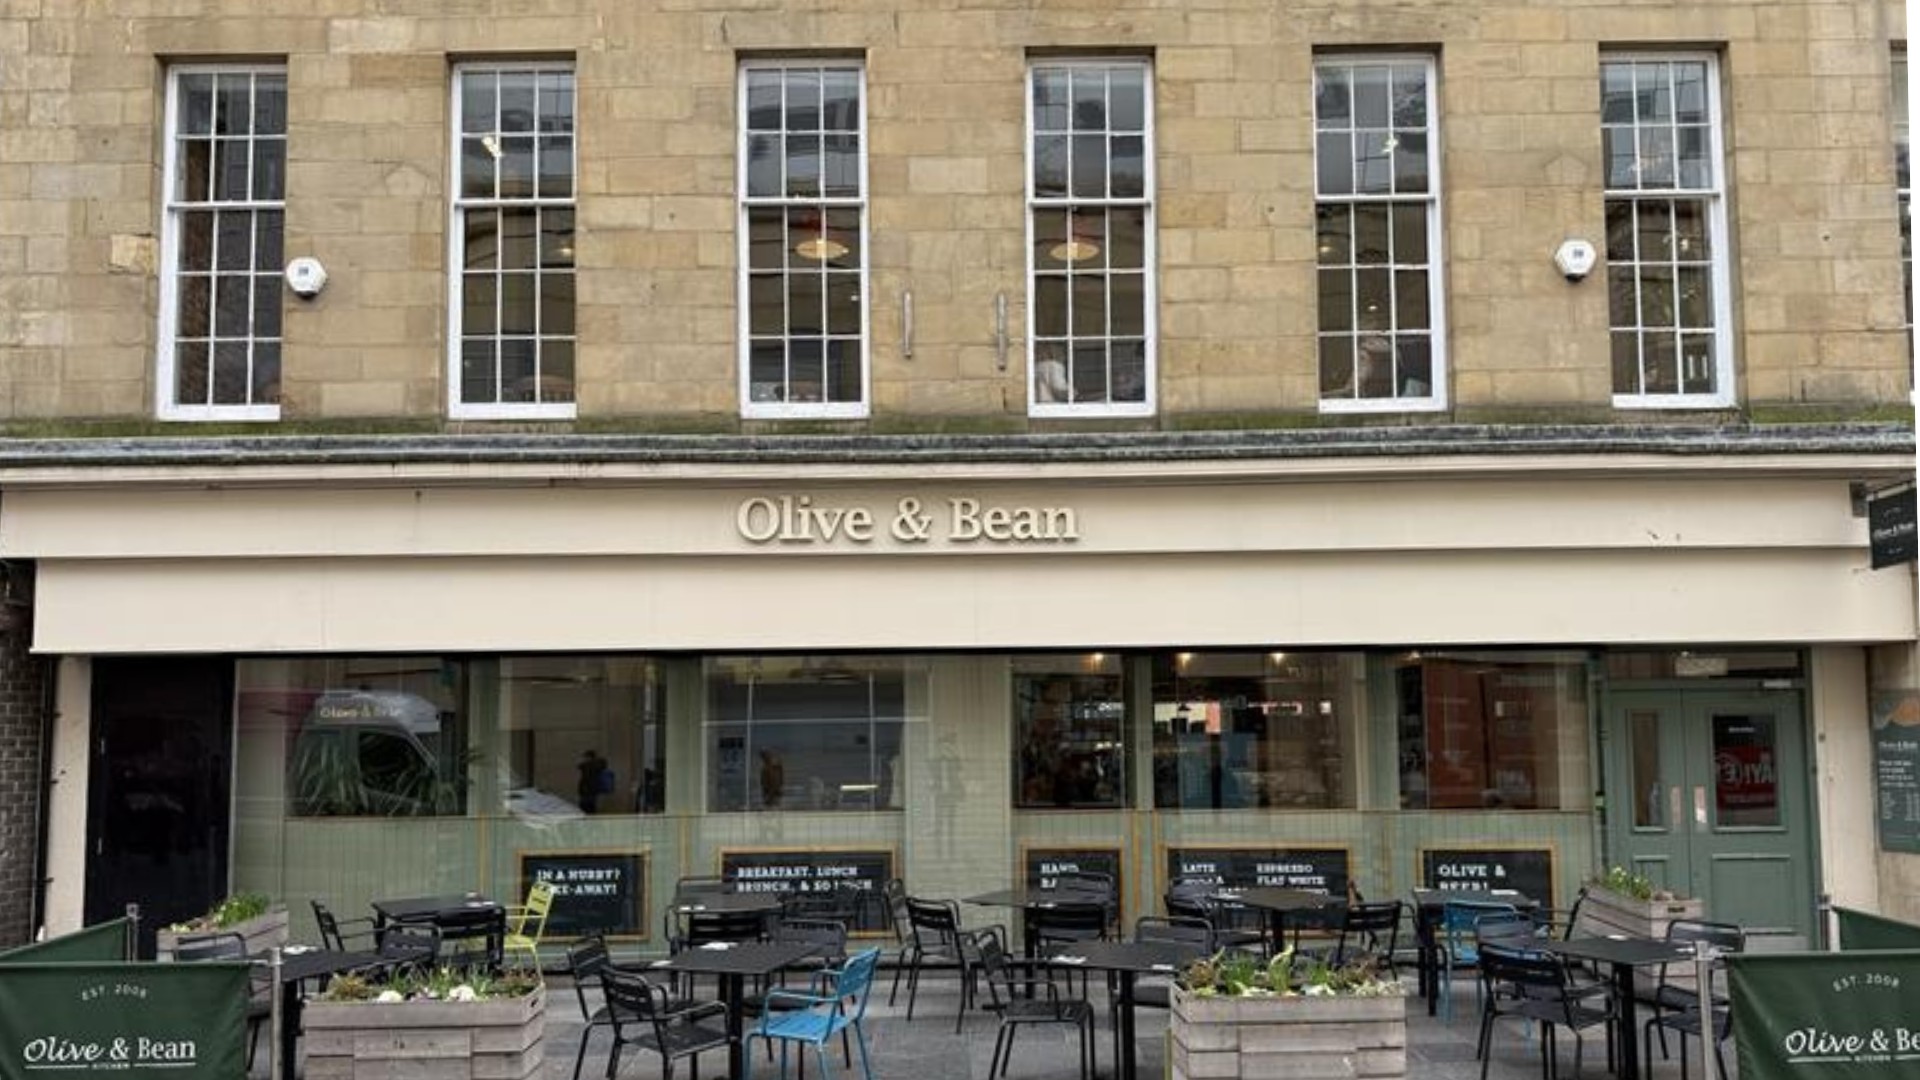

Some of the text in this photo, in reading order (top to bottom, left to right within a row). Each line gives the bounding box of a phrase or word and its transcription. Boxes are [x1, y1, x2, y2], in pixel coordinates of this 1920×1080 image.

[736, 495, 1078, 541] Olive & Bean
[1438, 864, 1487, 877] OLIVE
[23, 1036, 197, 1062] Olive & Bean
[1785, 1027, 1864, 1055] Olive
[1870, 1028, 1890, 1052] &
